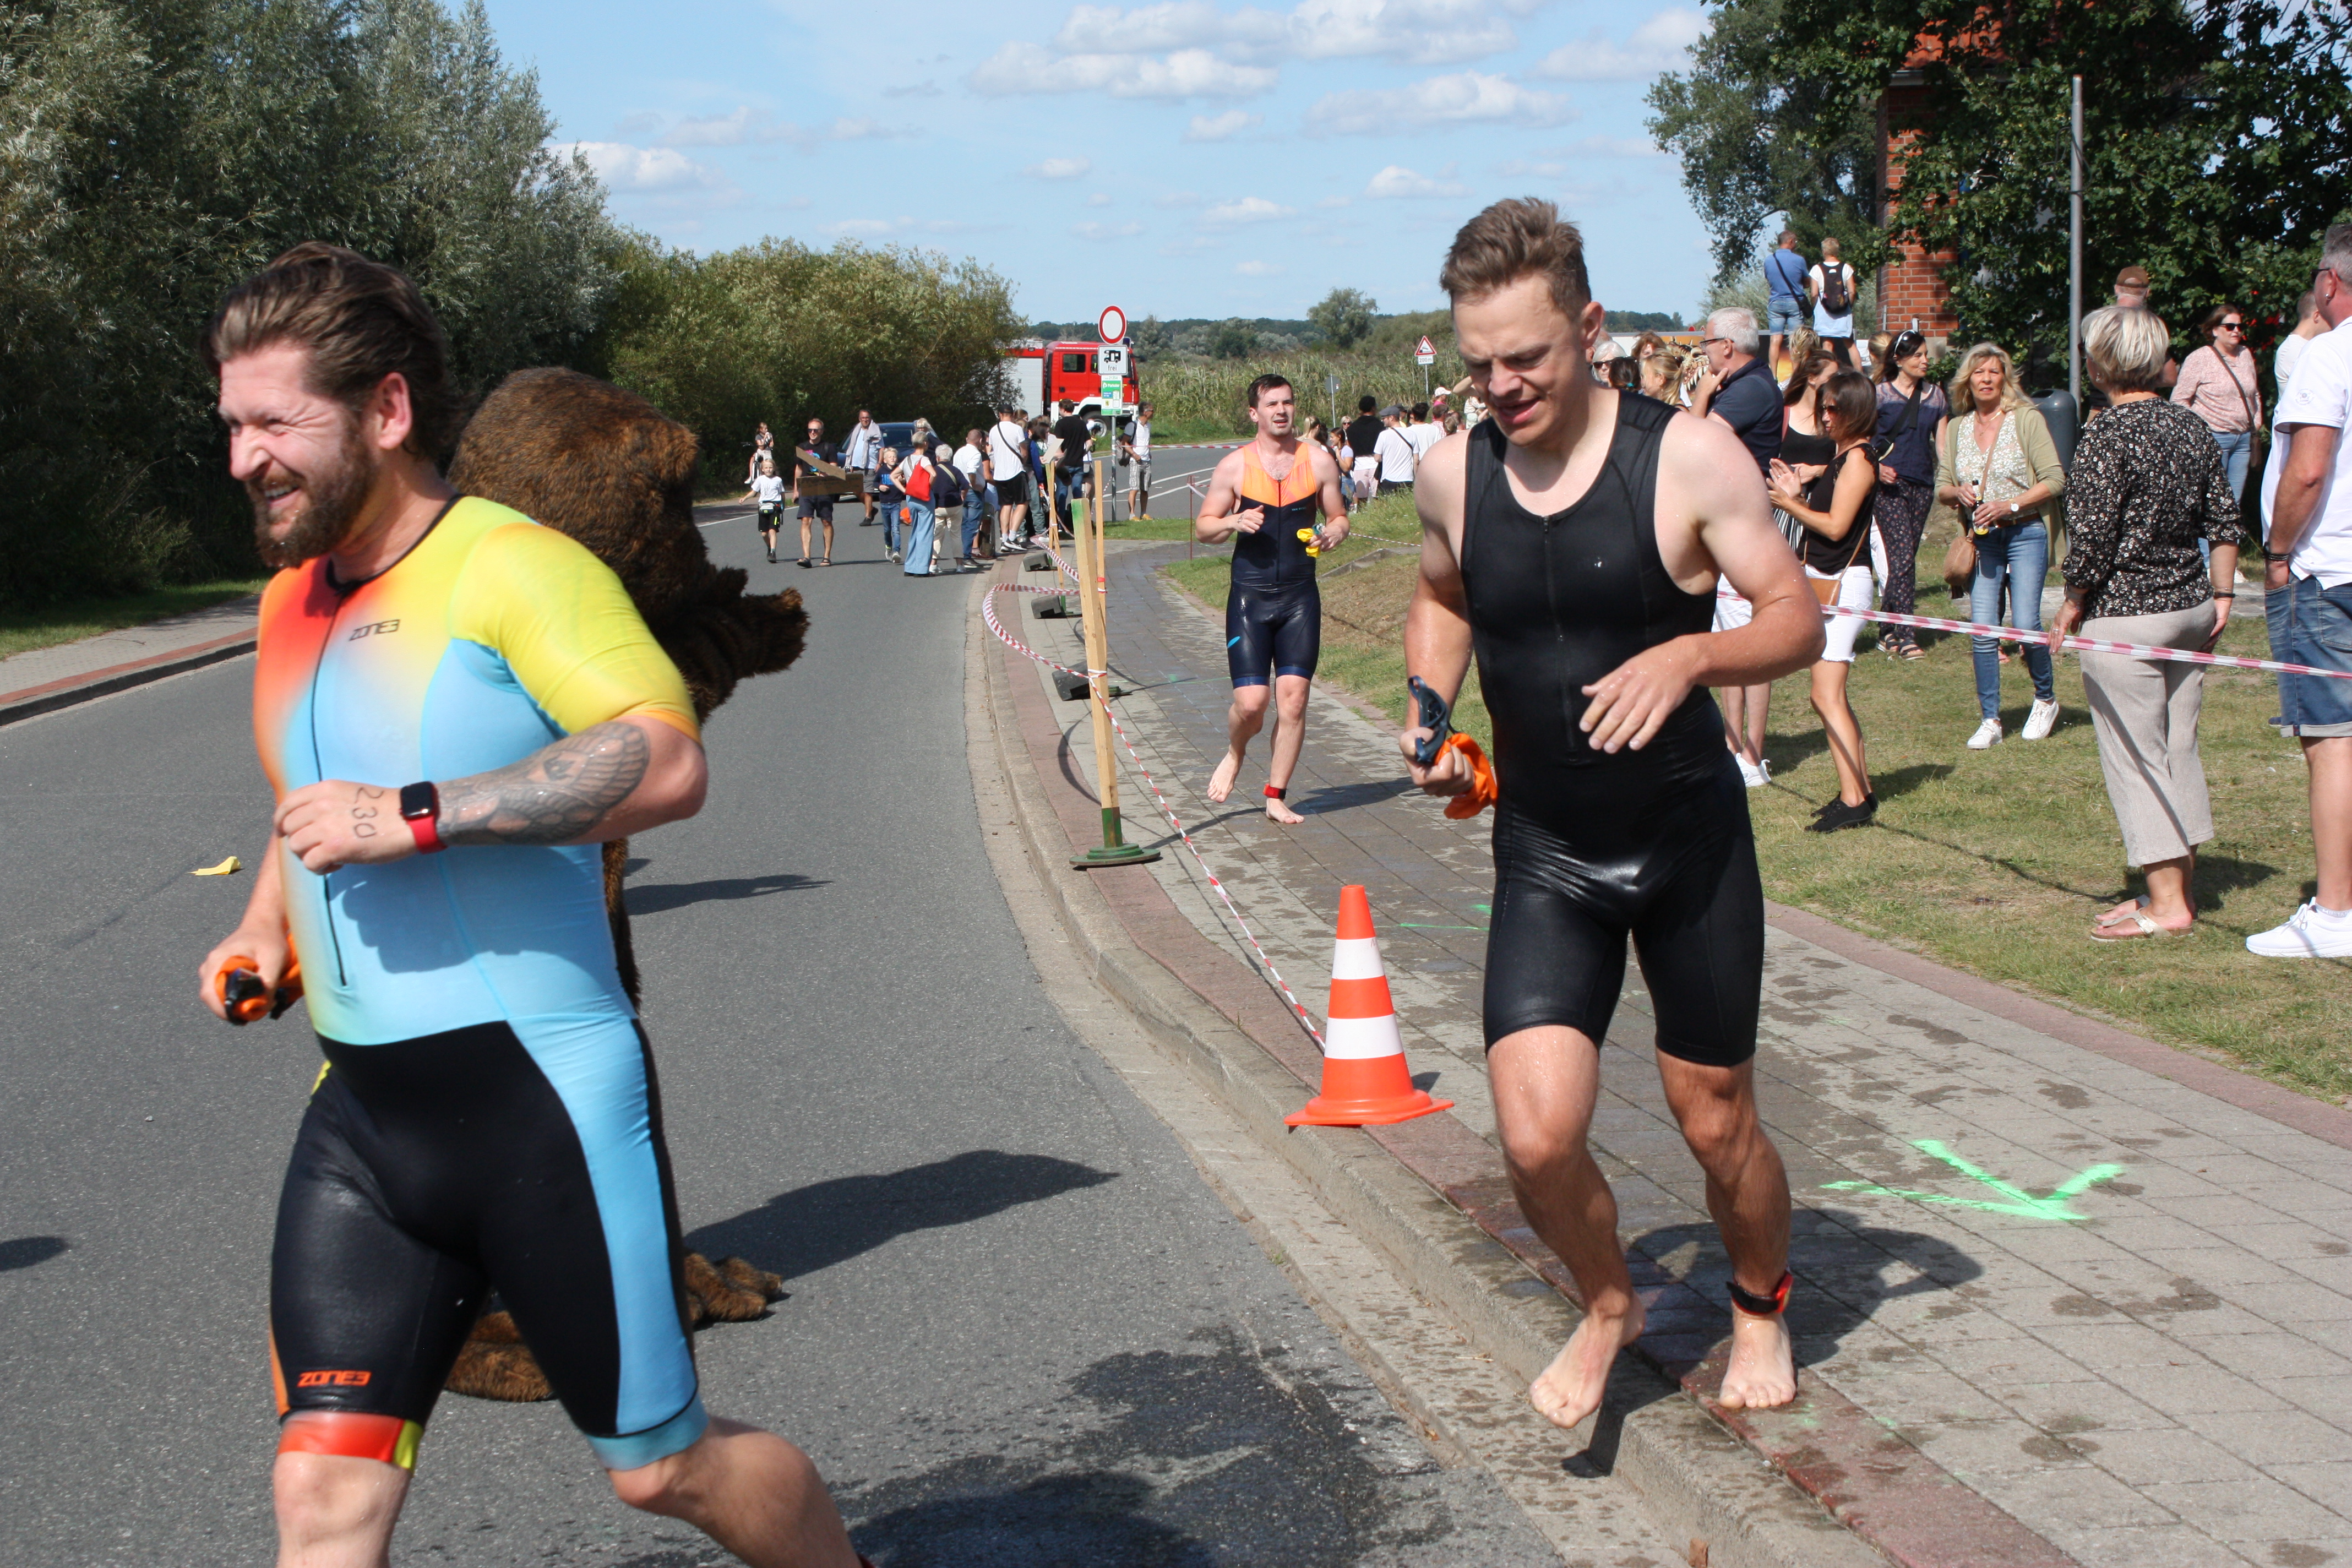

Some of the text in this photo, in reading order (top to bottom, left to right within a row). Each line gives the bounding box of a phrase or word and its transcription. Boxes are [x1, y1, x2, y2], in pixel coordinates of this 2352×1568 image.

[348, 619, 401, 642] ZONE3
[352, 787, 385, 839] 230
[297, 1369, 372, 1387] ZONE3
